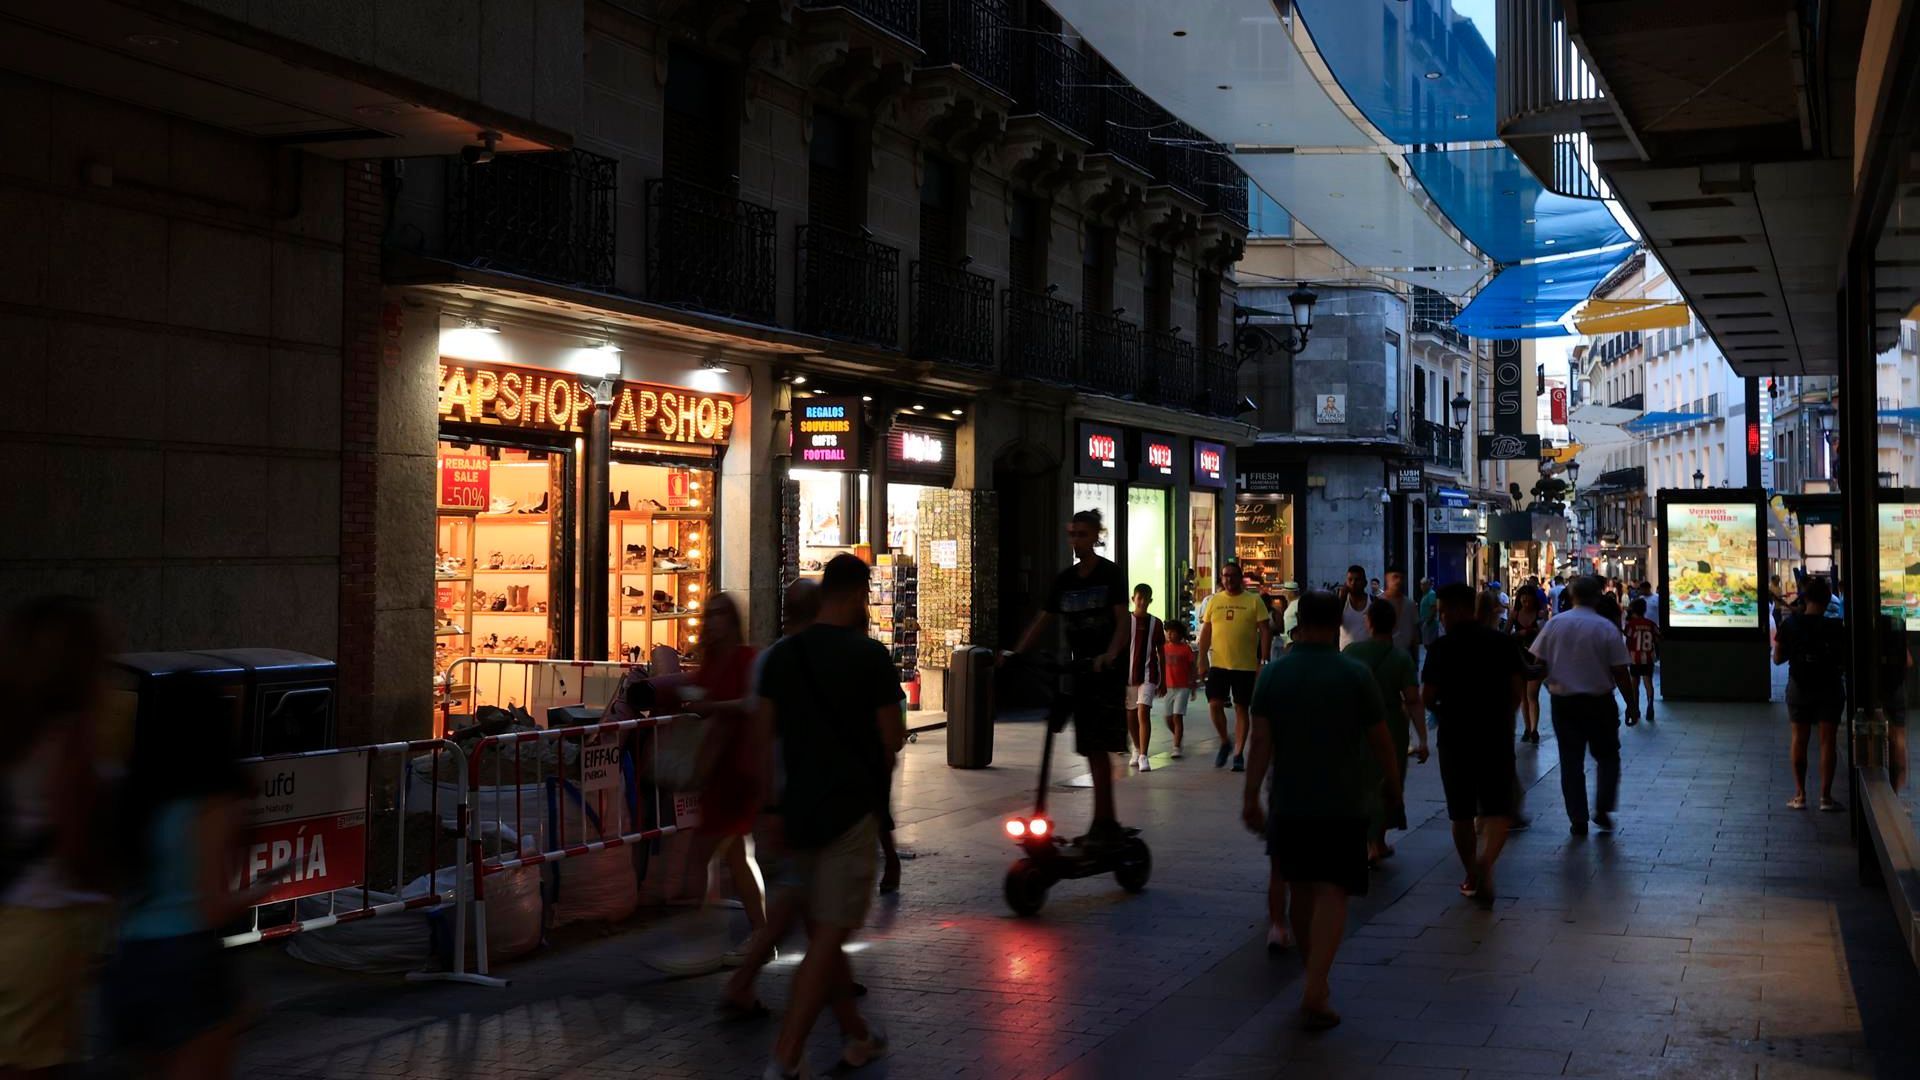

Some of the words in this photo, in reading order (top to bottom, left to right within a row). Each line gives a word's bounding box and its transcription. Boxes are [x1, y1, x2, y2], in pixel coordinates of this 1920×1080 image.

[610, 388, 735, 442] APSHOP
[805, 406, 845, 418] REGALOS
[800, 420, 850, 433] SOUVENIRS
[811, 434, 838, 447] GIFTS
[803, 449, 846, 461] FOOTBALL
[445, 458, 488, 471] REBAJAS
[453, 470, 479, 483] SALE
[1250, 472, 1280, 480] FRESH
[1399, 469, 1420, 477] LUSH
[447, 486, 485, 507] -50%
[1633, 630, 1652, 652] 18
[265, 771, 295, 798] ufd
